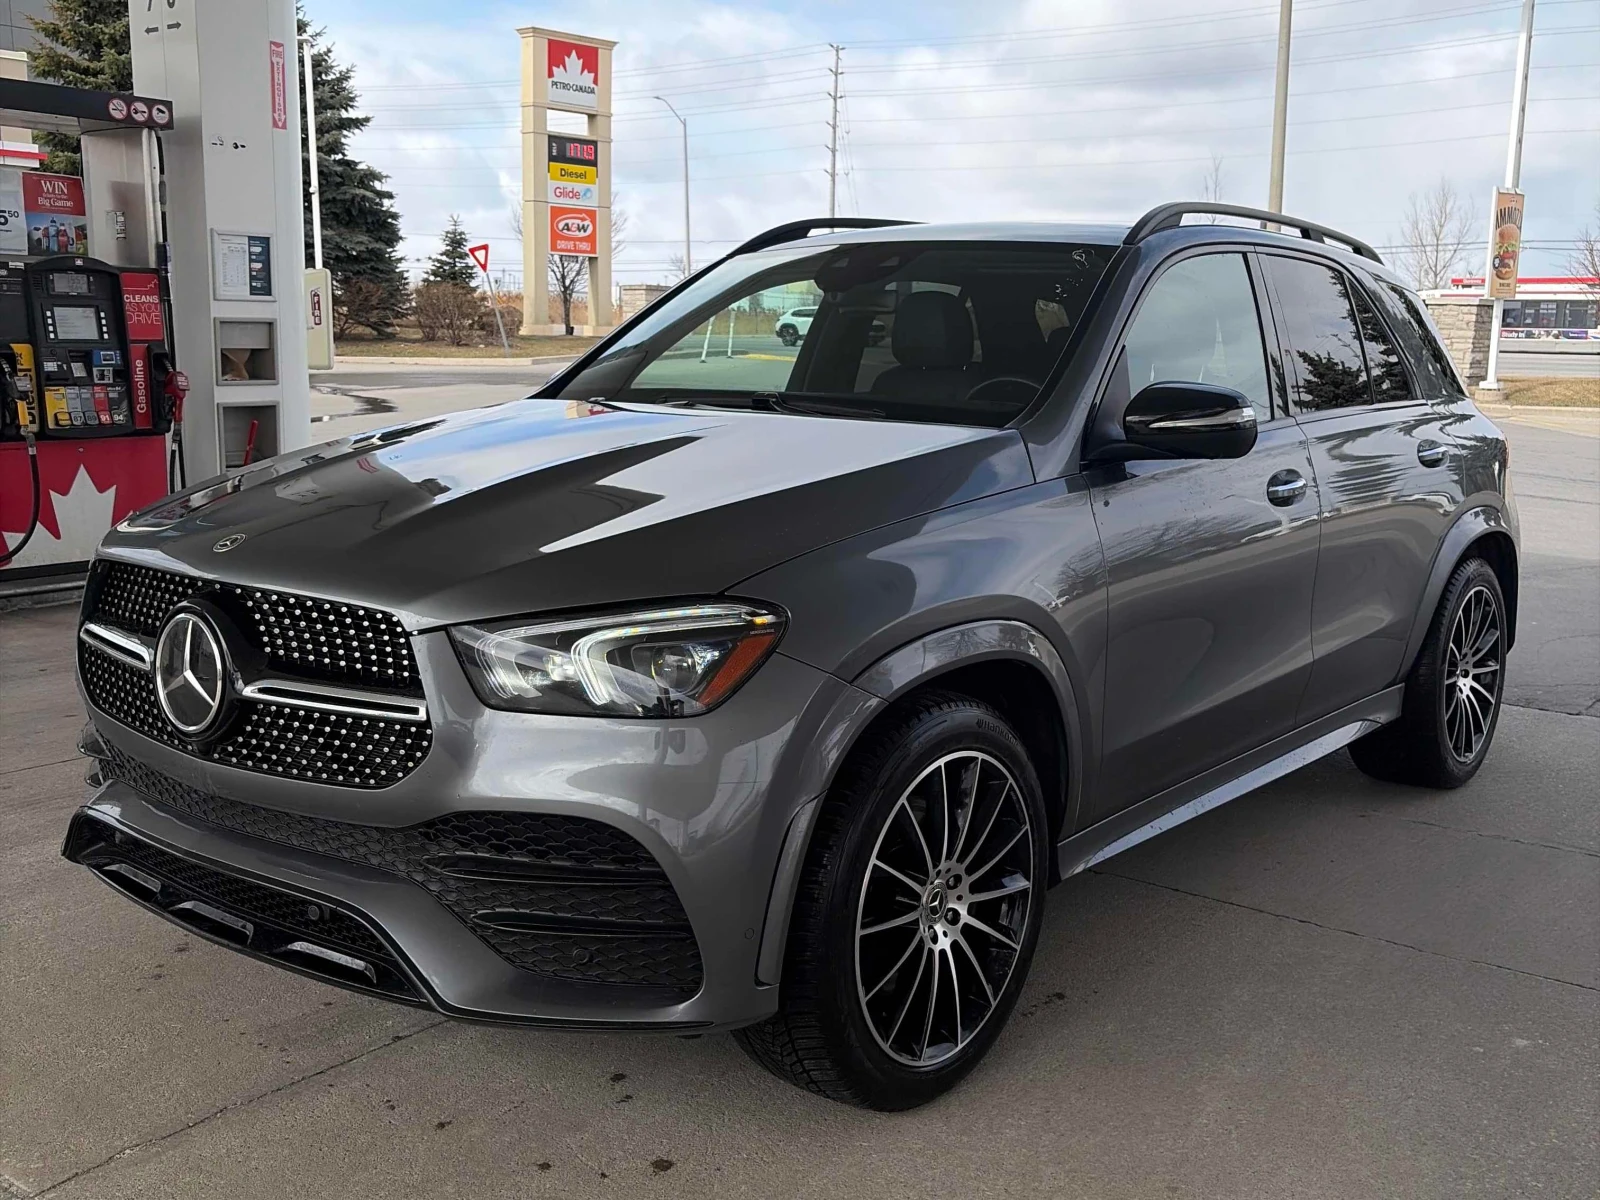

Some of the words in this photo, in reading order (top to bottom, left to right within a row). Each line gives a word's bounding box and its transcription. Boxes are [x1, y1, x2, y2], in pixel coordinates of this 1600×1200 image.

[560, 167, 587, 180] Diesel
[41, 180, 68, 194] WIN
[554, 186, 580, 200] Glide
[38, 197, 50, 206] Big
[51, 198, 74, 207] Game
[561, 222, 590, 233] A&W
[556, 240, 575, 250] DRIVE
[576, 242, 591, 251] THRU
[124, 294, 159, 303] CLEANS
[125, 303, 137, 312] AS
[140, 304, 160, 313] YOU
[127, 312, 161, 325] DRIVE
[135, 359, 147, 413] Gasoline
